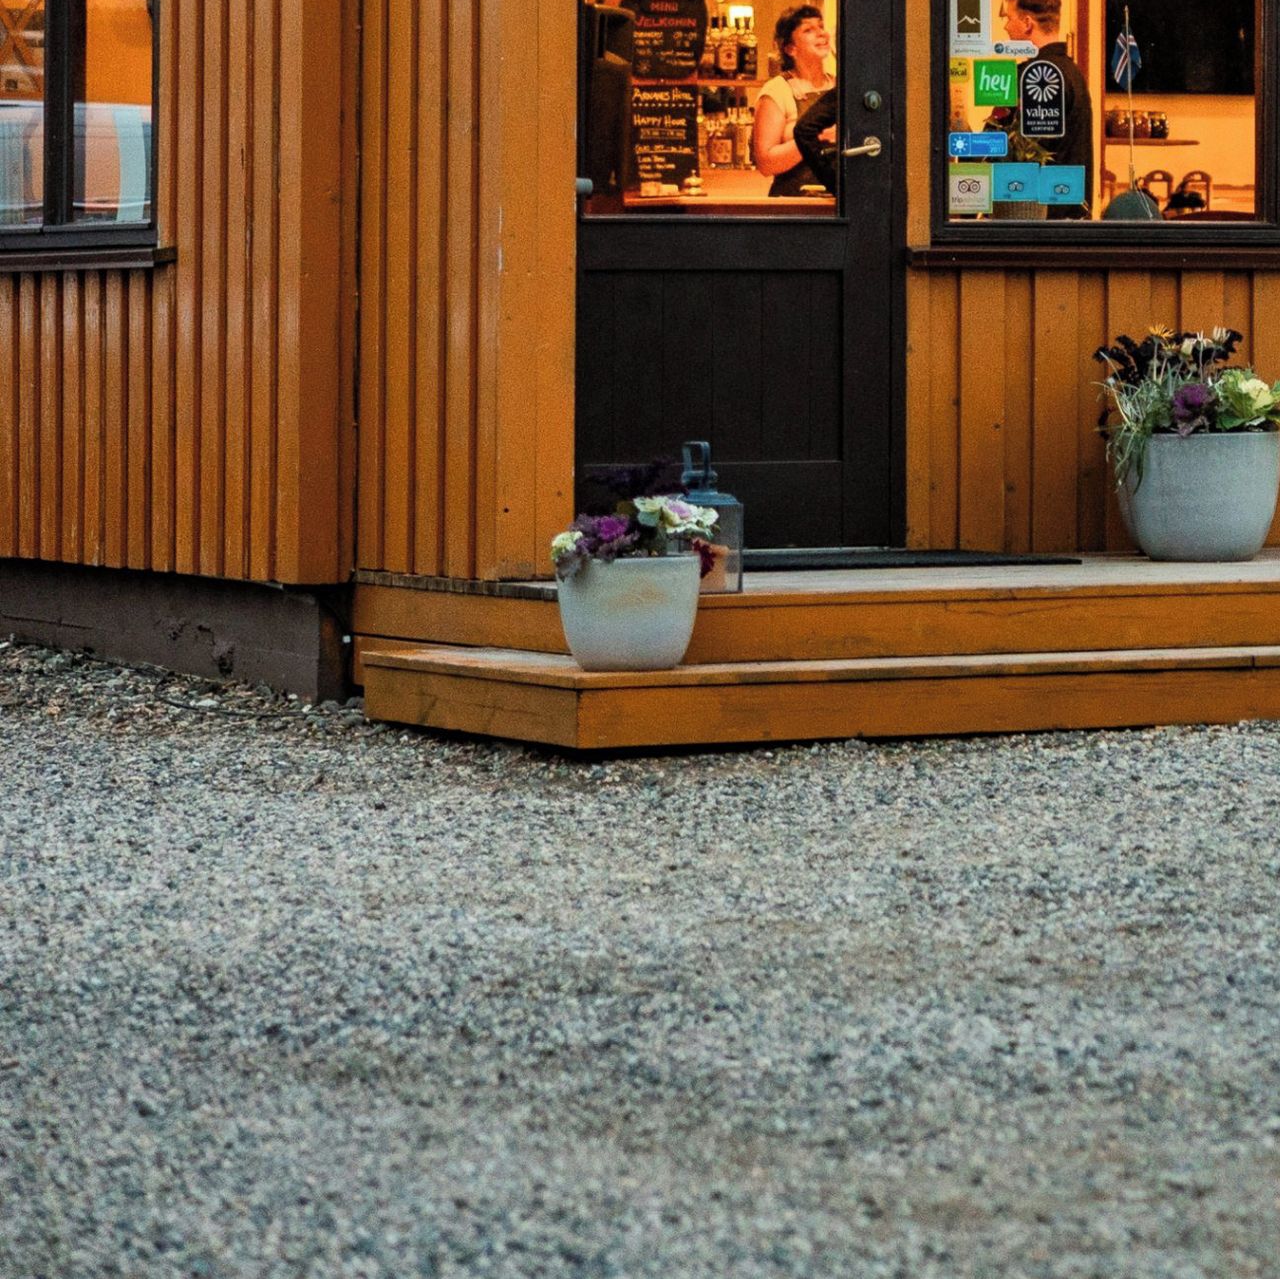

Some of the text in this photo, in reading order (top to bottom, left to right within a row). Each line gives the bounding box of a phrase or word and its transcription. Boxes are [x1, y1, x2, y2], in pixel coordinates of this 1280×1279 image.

[1005, 45, 1036, 57] Expedia
[979, 64, 1012, 100] hey
[1026, 104, 1060, 120] valpas
